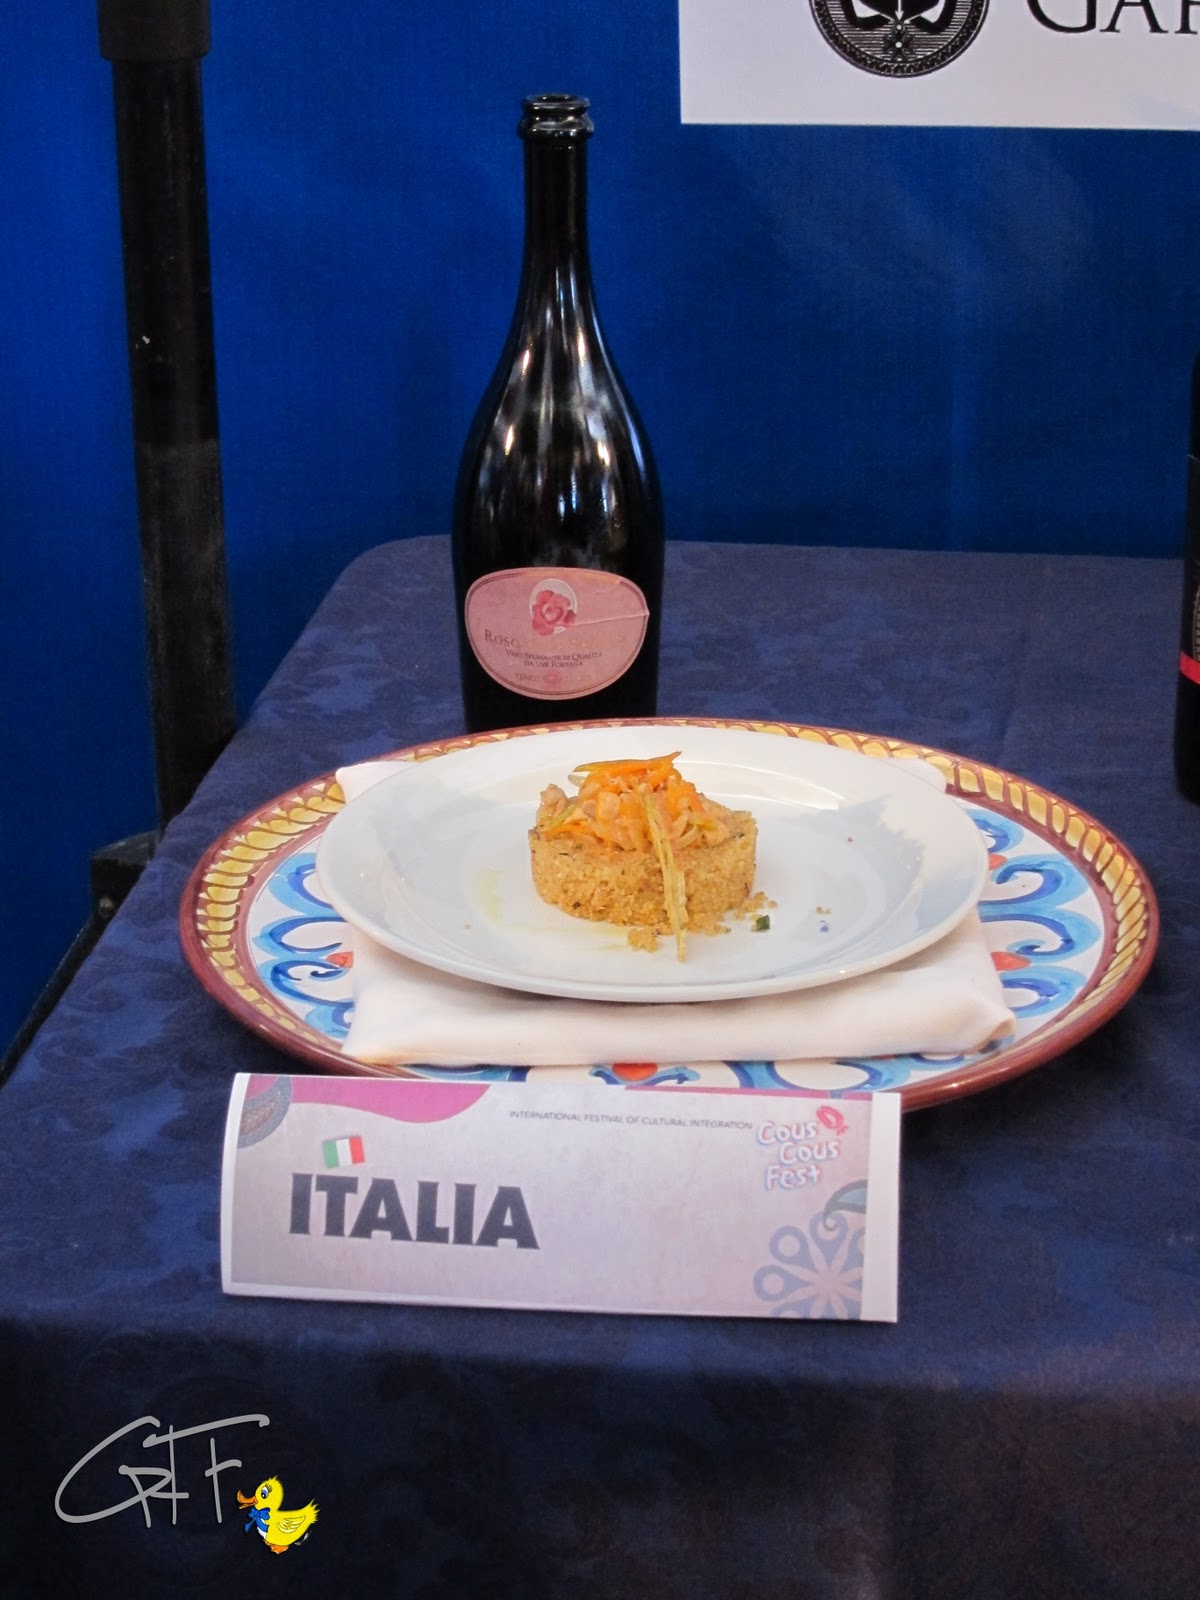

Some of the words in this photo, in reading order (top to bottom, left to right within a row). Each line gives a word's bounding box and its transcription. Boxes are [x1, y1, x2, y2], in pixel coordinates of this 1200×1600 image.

[509, 1110, 581, 1121] INTERNATIONAL
[584, 1113, 625, 1124] FESTIVAL
[626, 1114, 640, 1124] OF
[641, 1115, 688, 1127] CULTURAL
[690, 1118, 753, 1130] INTEGRATION
[756, 1120, 819, 1146] Cous
[778, 1140, 842, 1166] Cous
[764, 1163, 823, 1191] Fest
[289, 1172, 541, 1251] ITALIA
